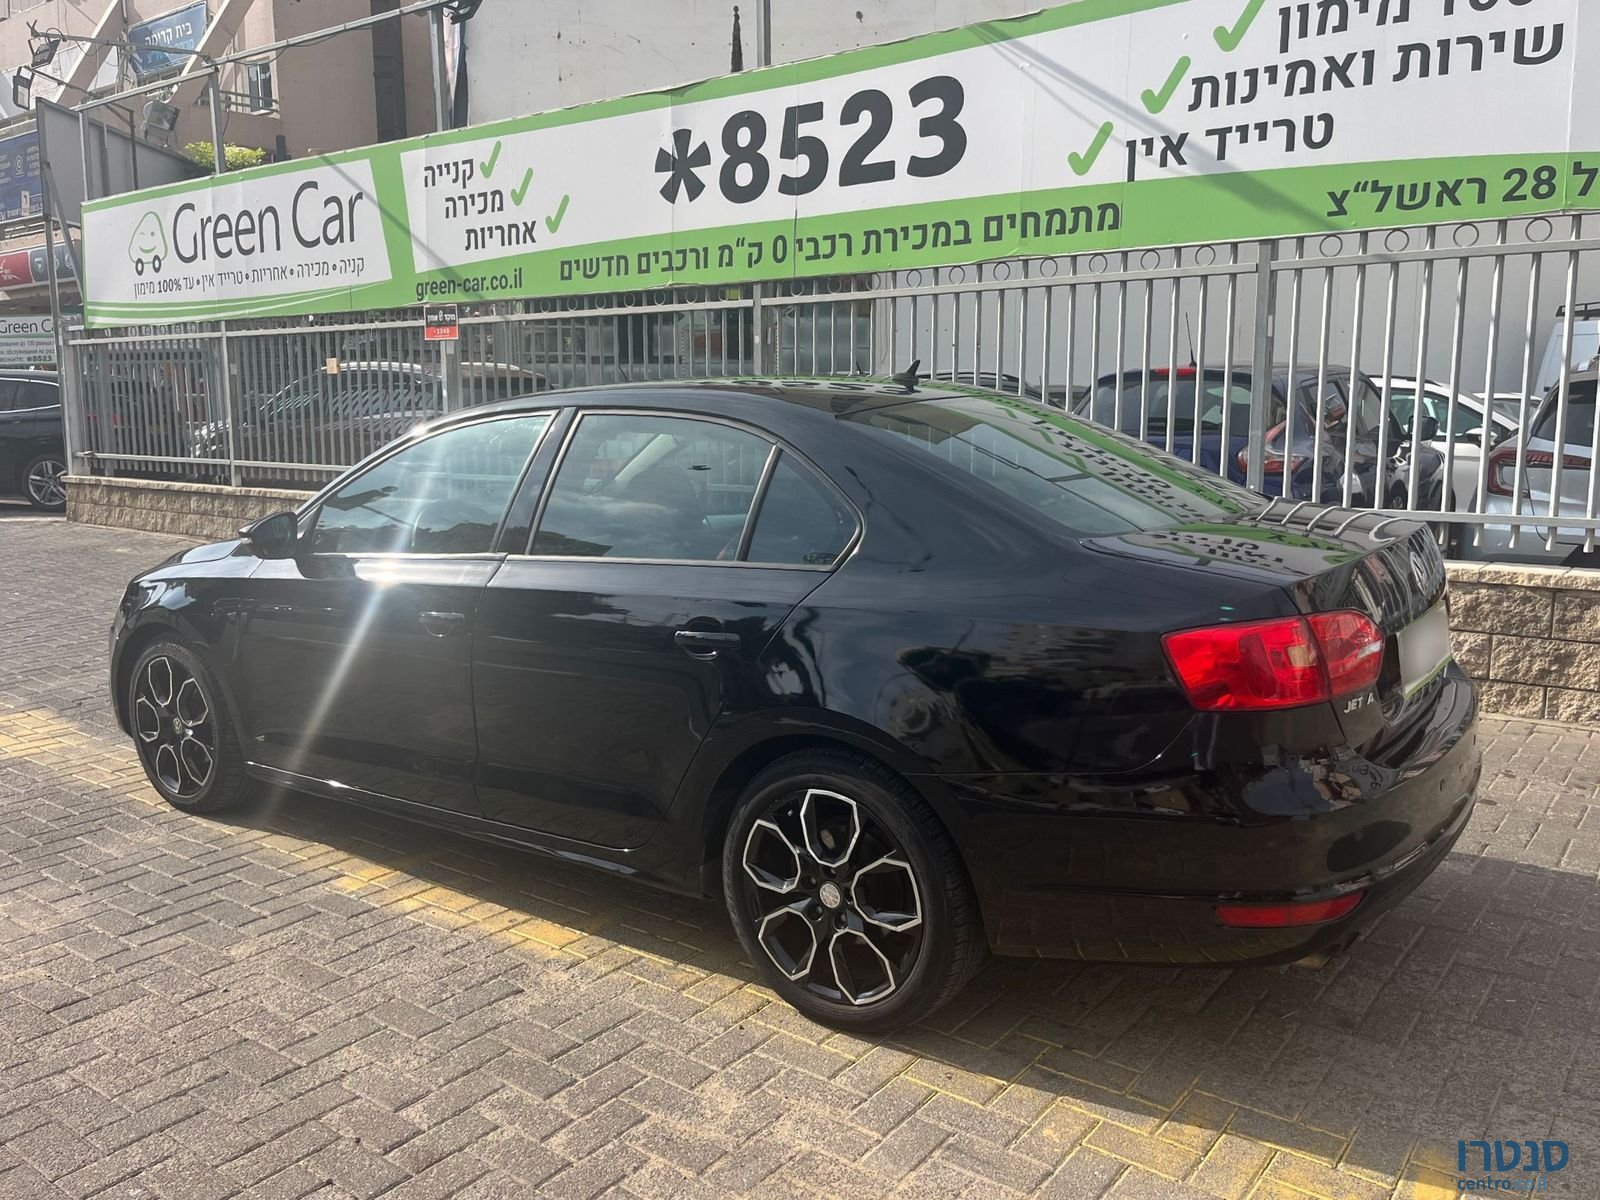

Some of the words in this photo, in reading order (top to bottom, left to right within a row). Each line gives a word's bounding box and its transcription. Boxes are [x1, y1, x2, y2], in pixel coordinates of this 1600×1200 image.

[175, 22, 193, 38] בית
[1392, 23, 1564, 82] שירות
[1187, 49, 1376, 113] ואמינות
[1204, 112, 1335, 161] טרייד
[1125, 132, 1190, 183] אין
[423, 158, 475, 189] קנייה
[1502, 165, 1558, 203] 28
[445, 189, 504, 219] מכירה
[172, 202, 281, 264] Green
[291, 180, 364, 249] Car
[464, 220, 537, 251] אחריות
[983, 202, 1120, 243] מתמחים
[772, 234, 788, 264] 0
[796, 232, 853, 262] רכבי
[861, 219, 972, 256] במכירת
[251, 266, 288, 284] אחריות
[297, 263, 329, 279] מכירה
[339, 257, 365, 275] קניה
[560, 254, 629, 281] חדשים
[637, 246, 709, 275] ורכבים
[133, 280, 156, 300] מימון
[157, 279, 182, 294] 100%
[183, 278, 195, 291] עד
[201, 274, 215, 293] אין
[216, 271, 244, 287] טרייד
[416, 267, 523, 301] green-car.co.il
[0, 319, 38, 333] Green
[41, 318, 54, 333] C
